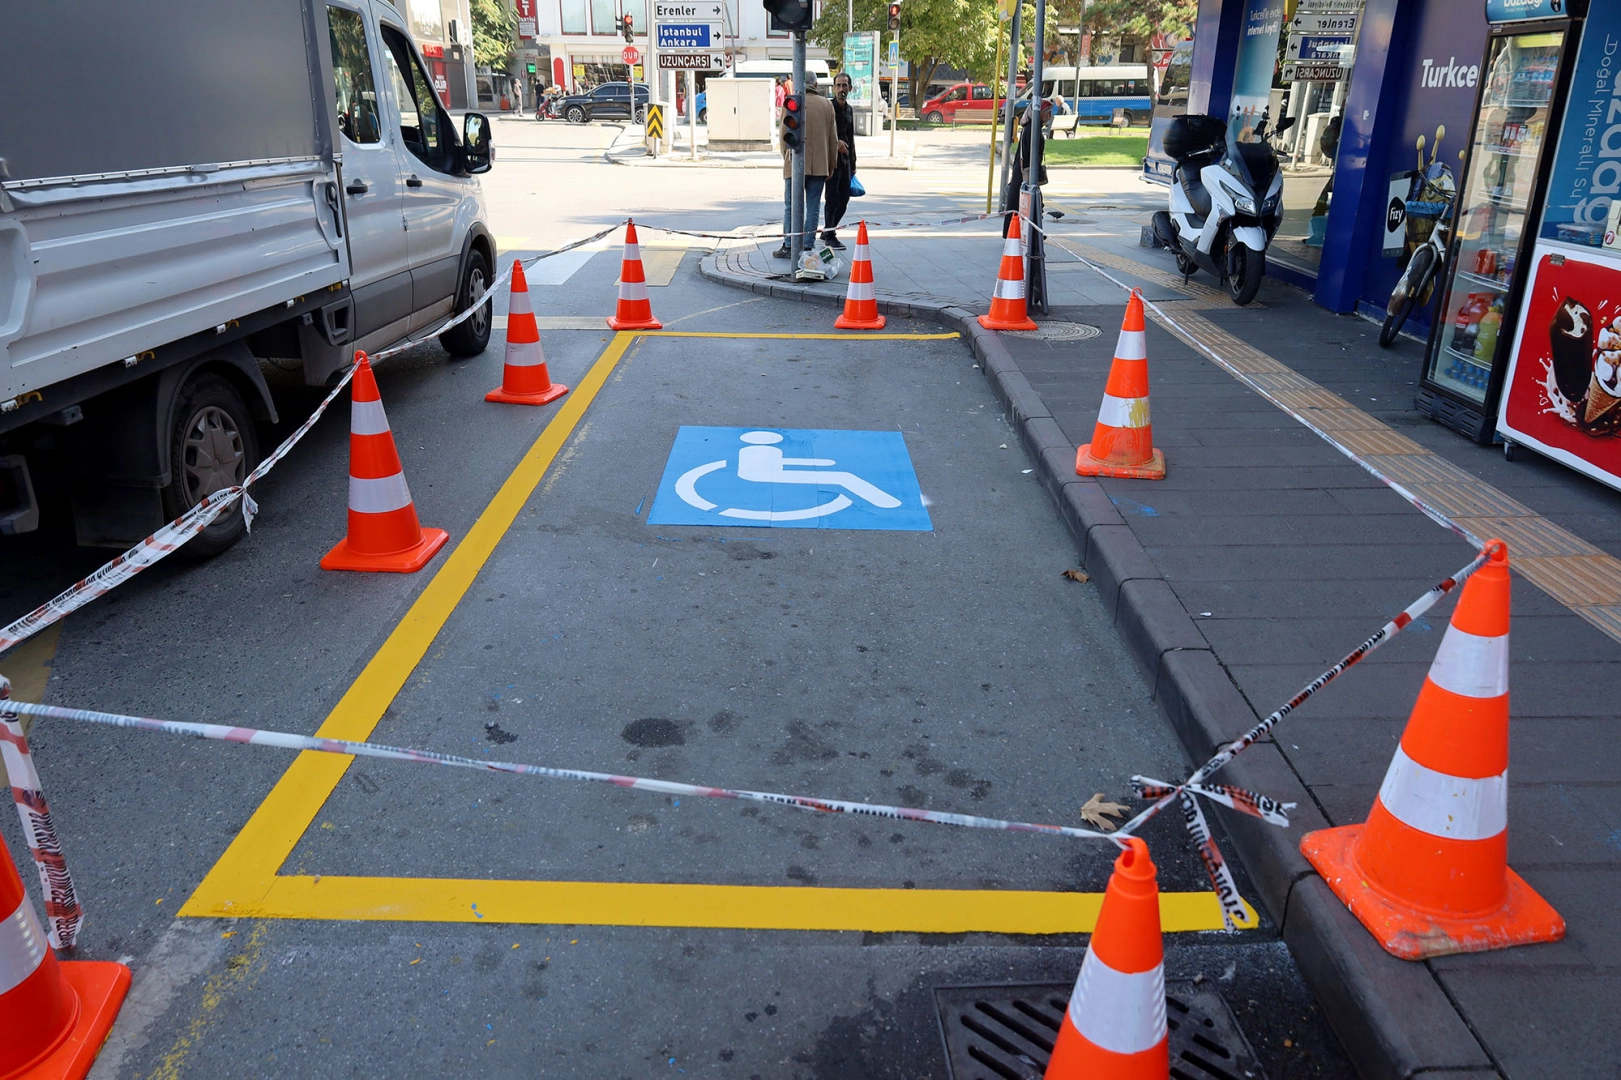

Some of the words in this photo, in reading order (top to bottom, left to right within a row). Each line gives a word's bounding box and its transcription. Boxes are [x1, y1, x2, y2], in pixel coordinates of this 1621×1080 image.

[657, 5, 696, 16] Erenler
[1270, 6, 1282, 18] evde
[660, 25, 702, 37] İstanbul
[1247, 24, 1265, 36] internet
[660, 38, 697, 47] Ankara
[660, 56, 710, 67] UZUNÇARŞI
[1594, 33, 1618, 94] Doğal
[1570, 177, 1587, 198] Su
[1389, 207, 1403, 223] fizy
